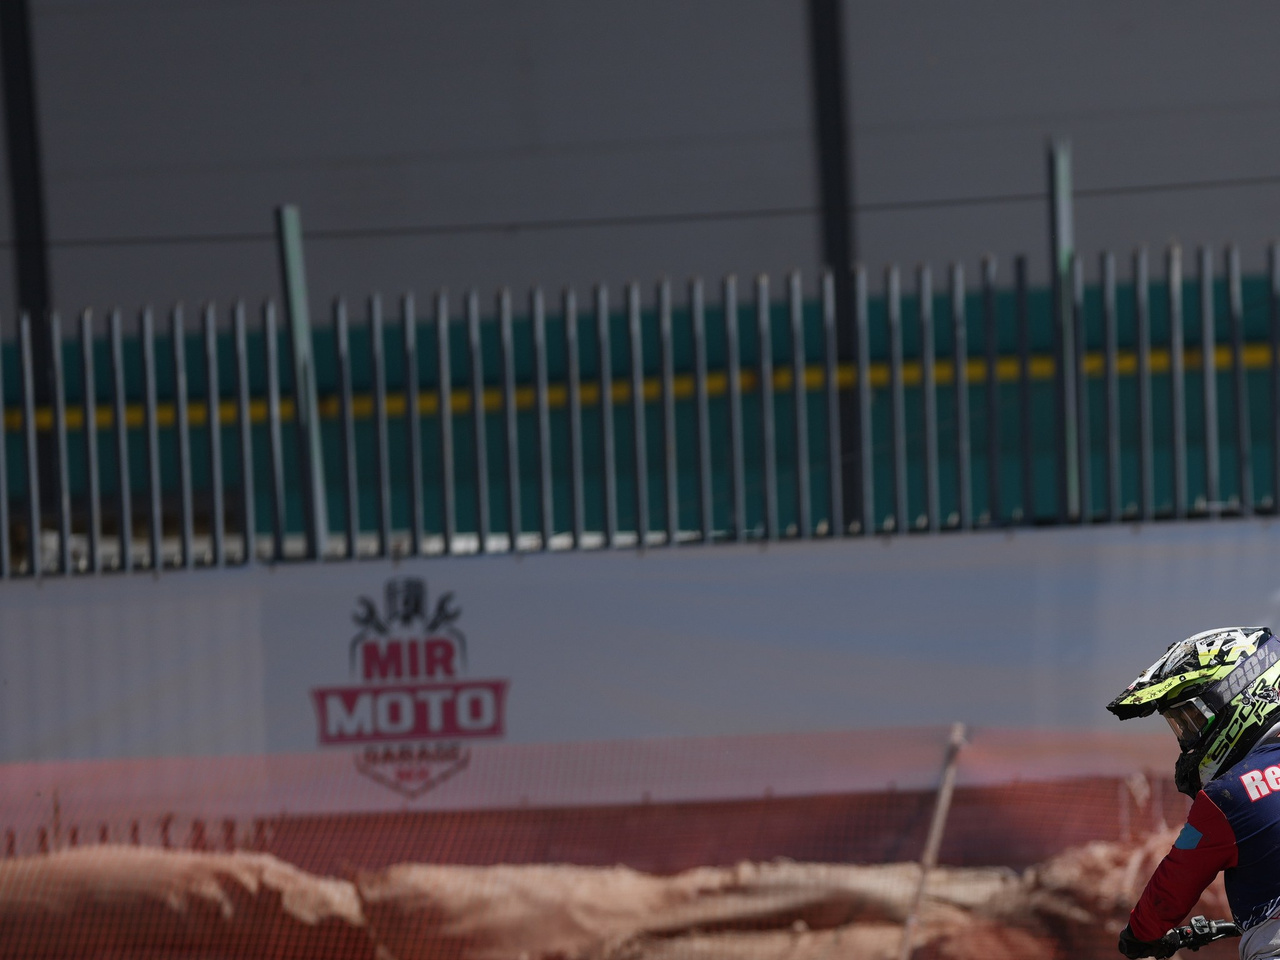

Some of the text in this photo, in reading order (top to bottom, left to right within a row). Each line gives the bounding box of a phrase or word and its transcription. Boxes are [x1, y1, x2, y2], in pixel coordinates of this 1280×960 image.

[361, 636, 456, 681] MIR
[1216, 644, 1279, 704] 100%
[324, 687, 496, 739] MOTO
